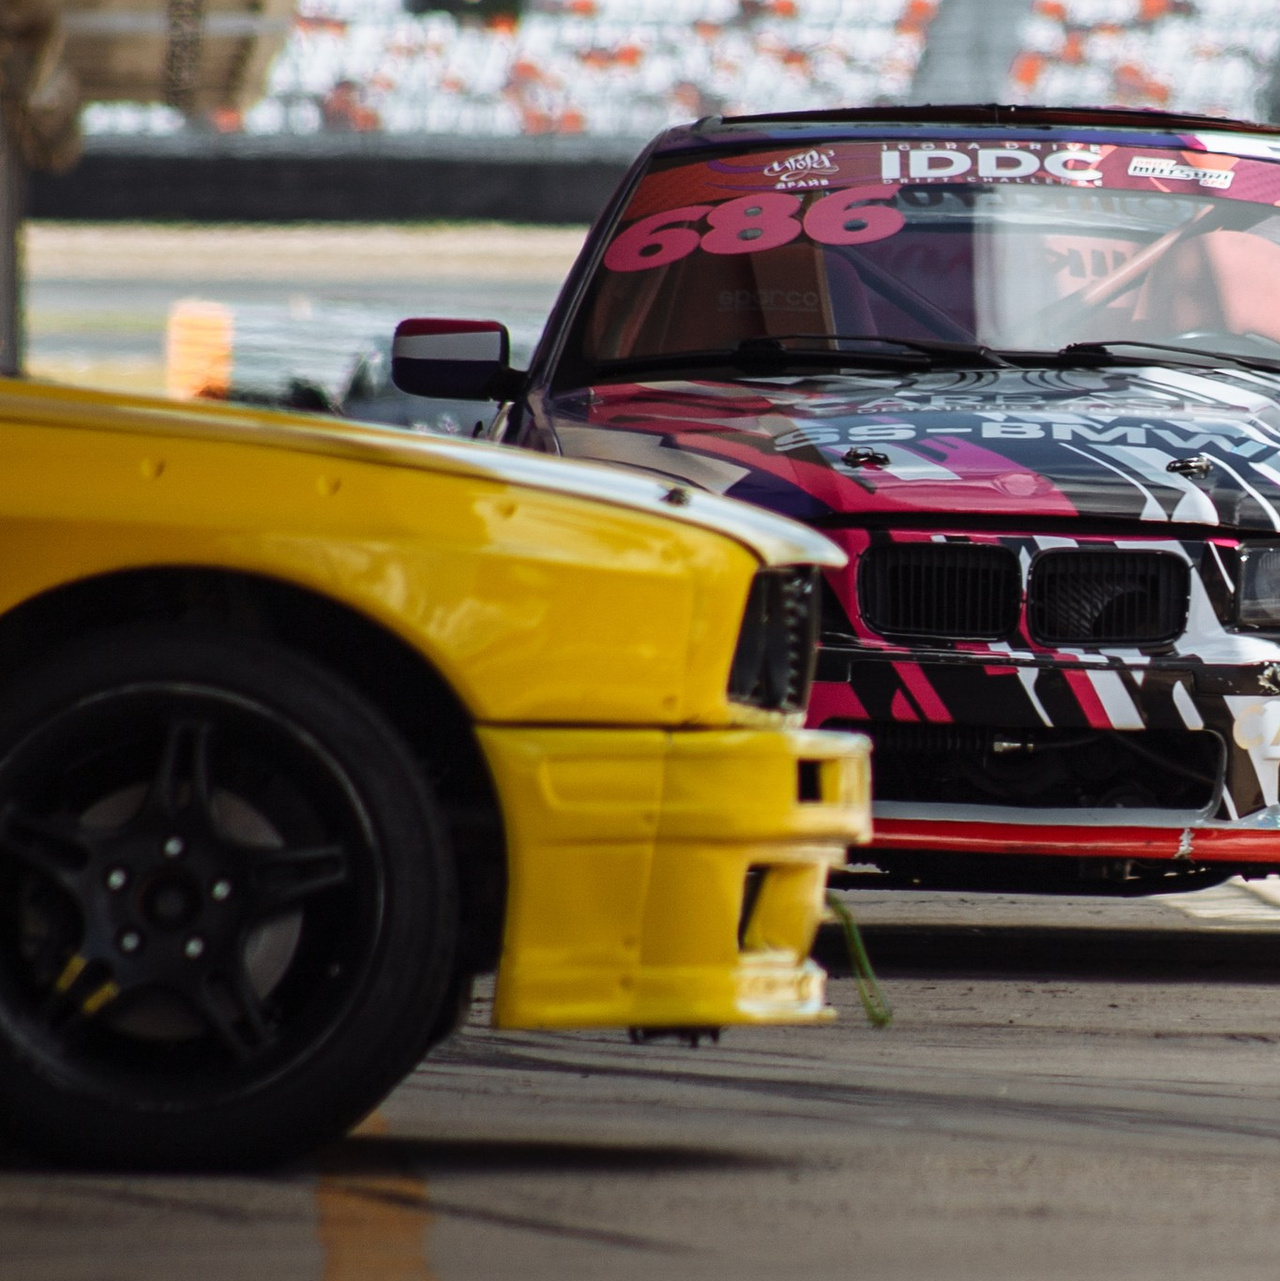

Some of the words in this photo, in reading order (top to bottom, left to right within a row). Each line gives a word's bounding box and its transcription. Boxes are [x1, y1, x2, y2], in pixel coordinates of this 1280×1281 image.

[881, 141, 981, 151] IGORA
[1005, 142, 1103, 153] DRIVE
[881, 149, 1103, 181] IDDC
[882, 177, 949, 185] DRIFT
[604, 185, 904, 272] 686
[794, 392, 1232, 414] CARBASE
[774, 422, 1271, 455] SS-BMW
